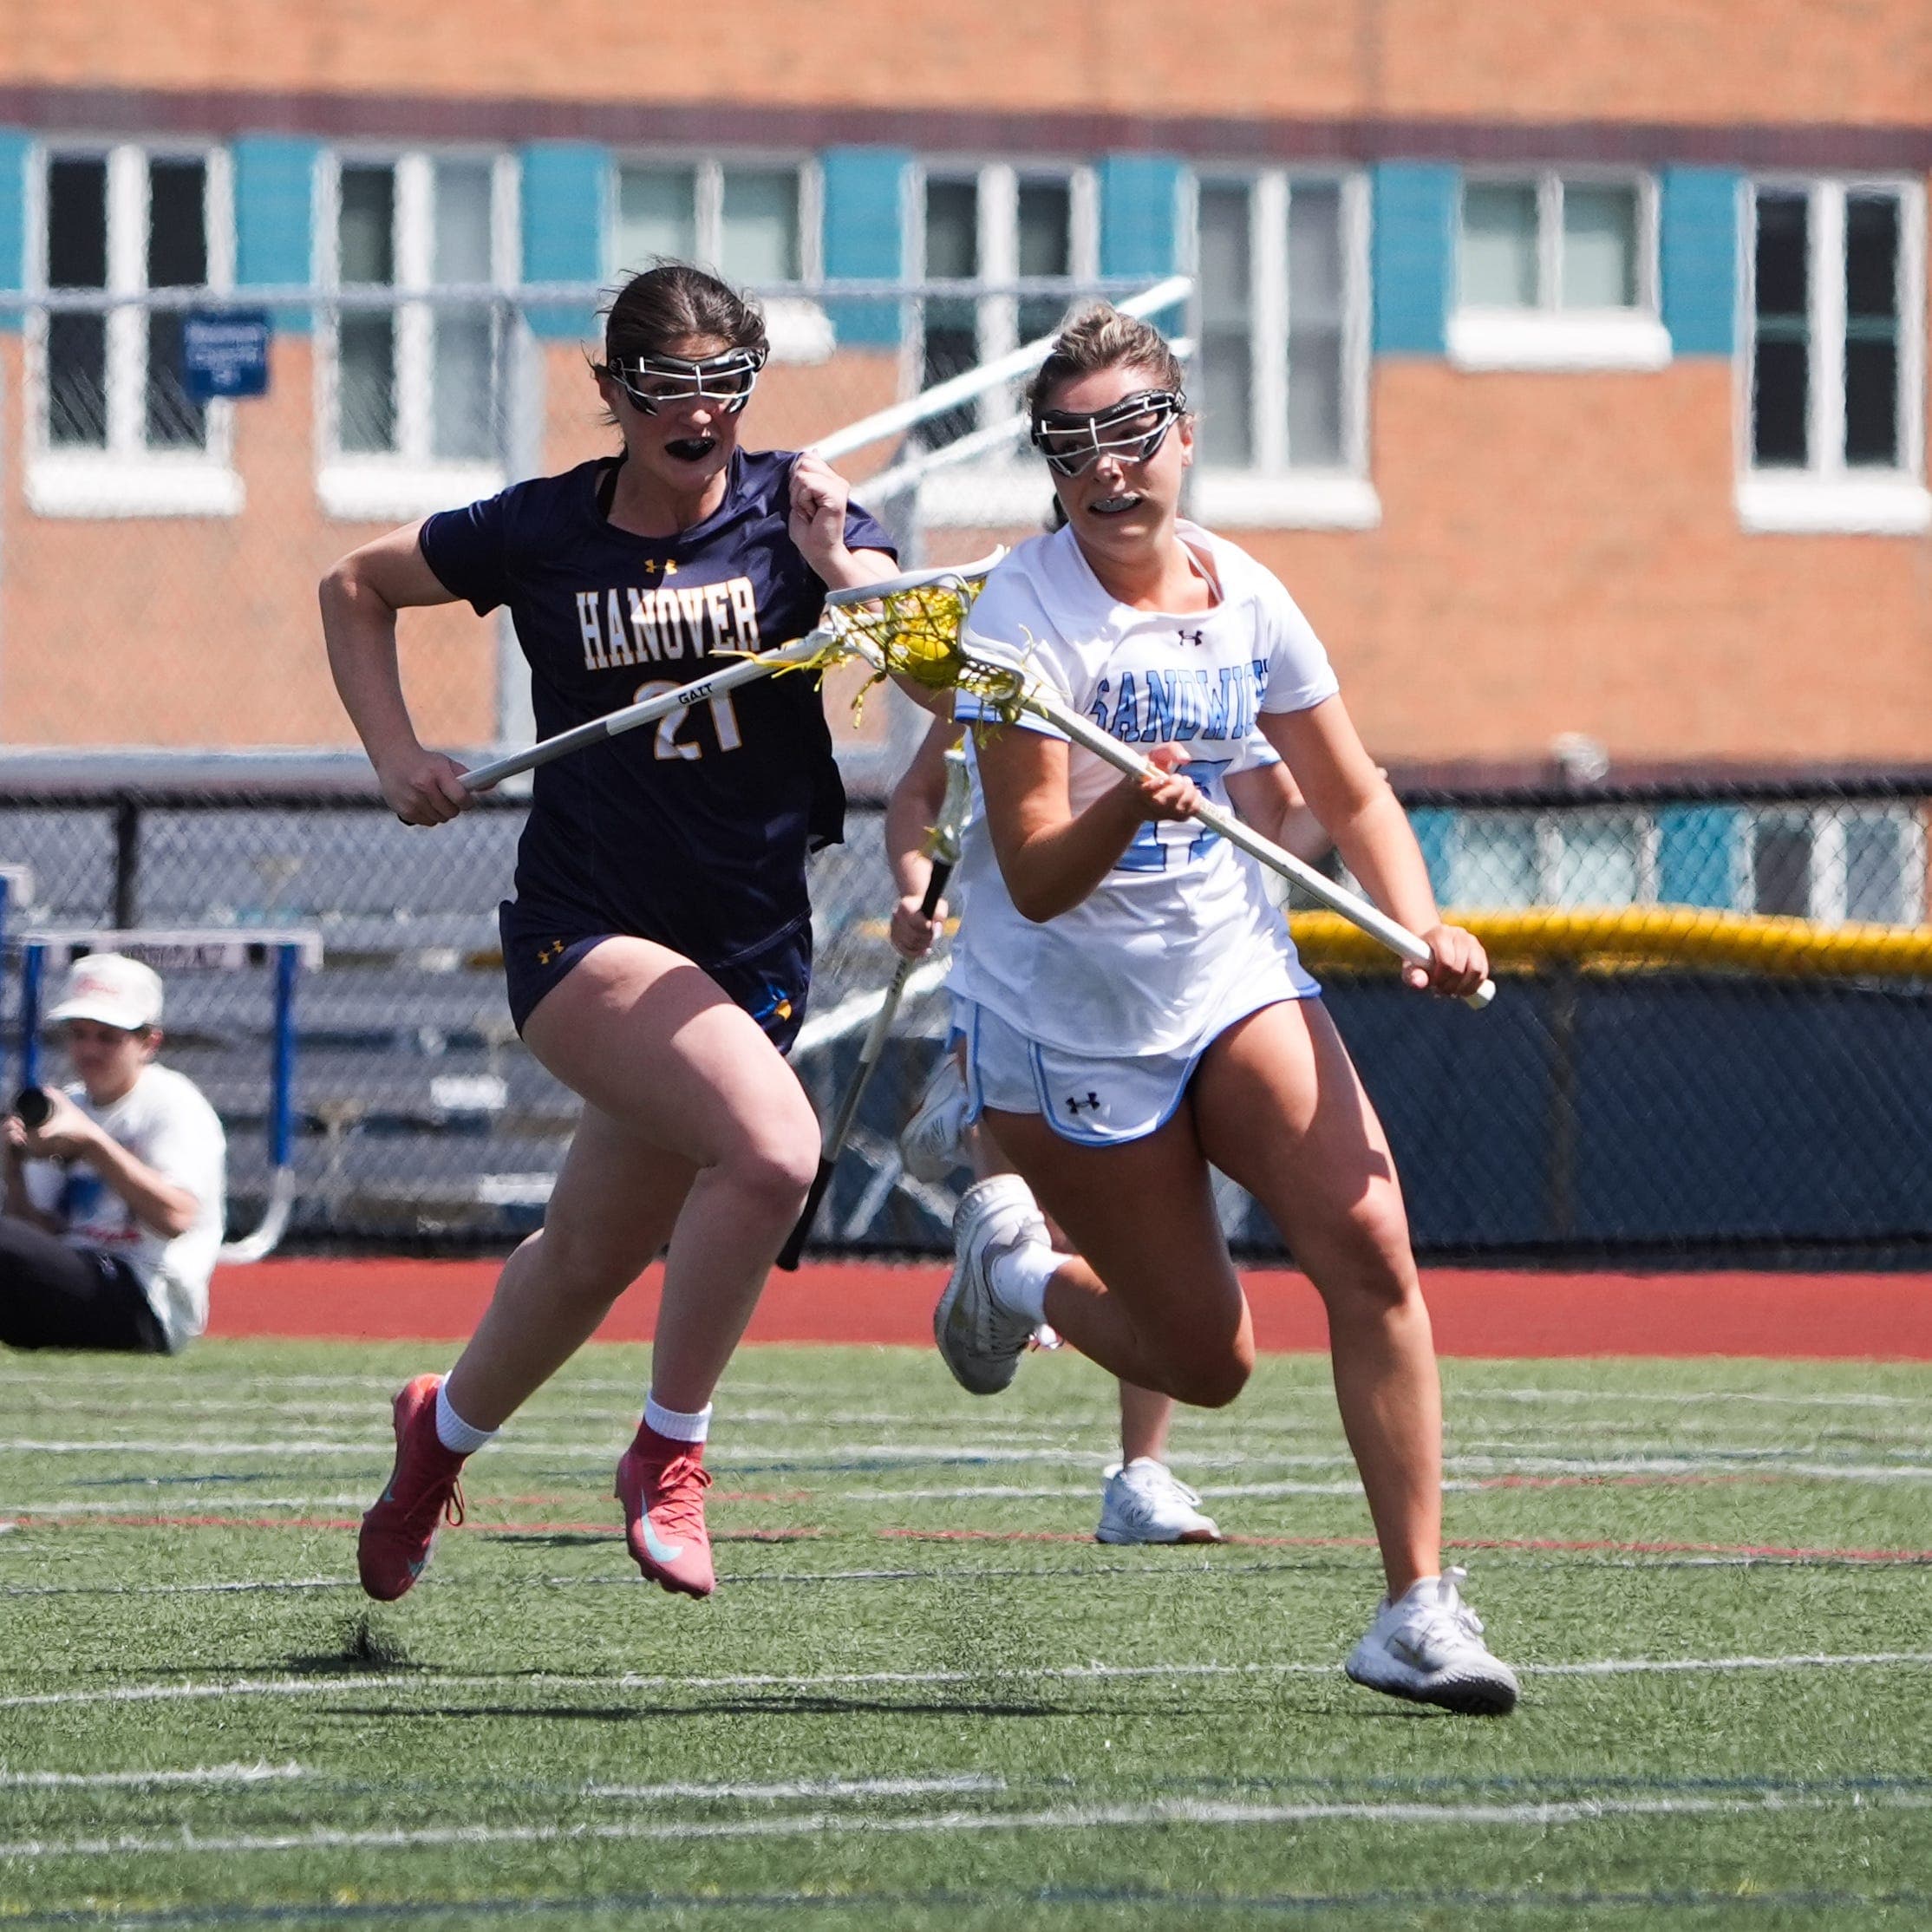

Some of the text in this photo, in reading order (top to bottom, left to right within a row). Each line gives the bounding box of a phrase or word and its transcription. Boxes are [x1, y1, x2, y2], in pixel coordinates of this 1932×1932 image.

[576, 576, 761, 670] HANOVER
[633, 680, 743, 760] 21
[678, 682, 713, 704] GAIT
[1089, 658, 1270, 742] SANDWIC
